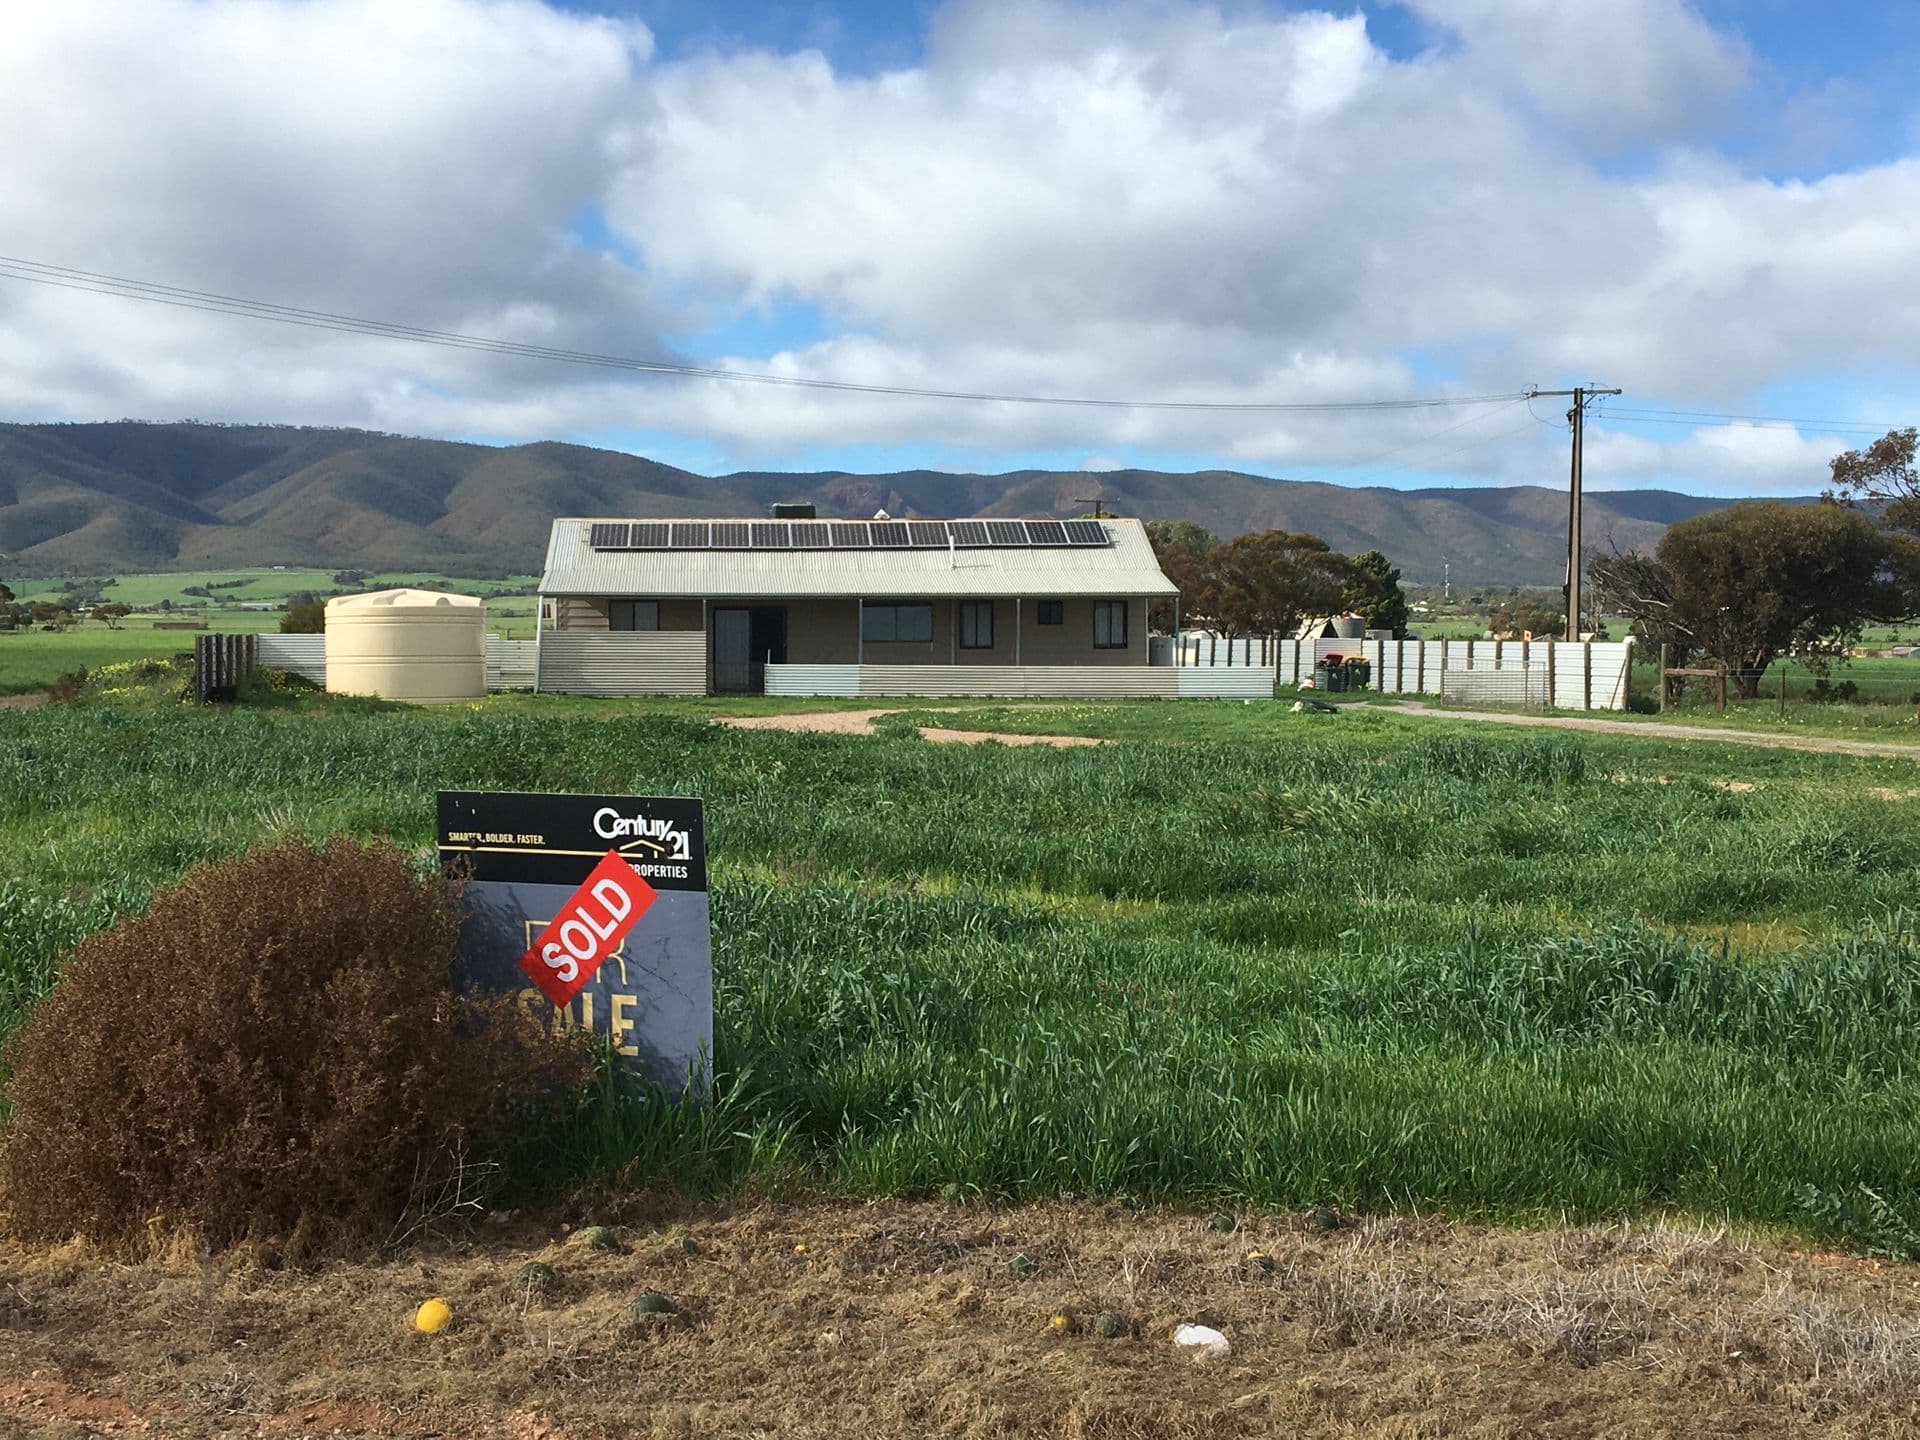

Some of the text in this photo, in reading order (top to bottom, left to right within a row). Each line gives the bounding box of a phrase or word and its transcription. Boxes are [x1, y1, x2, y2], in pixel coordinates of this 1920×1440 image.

[485, 833, 516, 844] BOLDER.
[517, 834, 546, 845] FASTER.
[593, 807, 673, 841] Century
[665, 830, 690, 860] 21
[541, 878, 632, 983] SOLD
